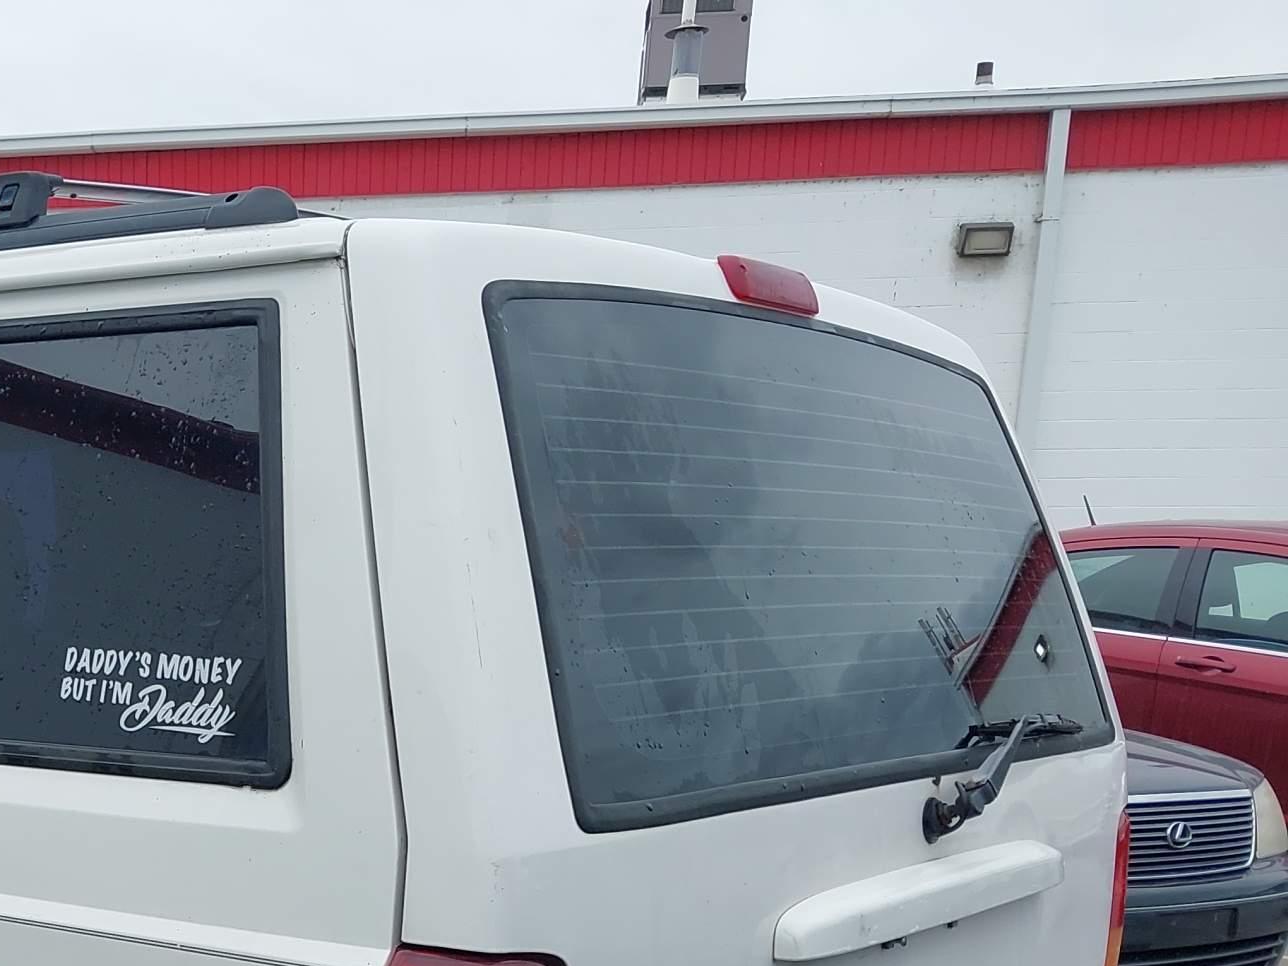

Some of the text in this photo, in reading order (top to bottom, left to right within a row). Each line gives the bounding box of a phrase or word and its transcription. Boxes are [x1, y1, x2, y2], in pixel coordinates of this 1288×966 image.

[64, 646, 242, 685] DADDY'S MONEY
[59, 676, 236, 744] BUT I'M Daddy
